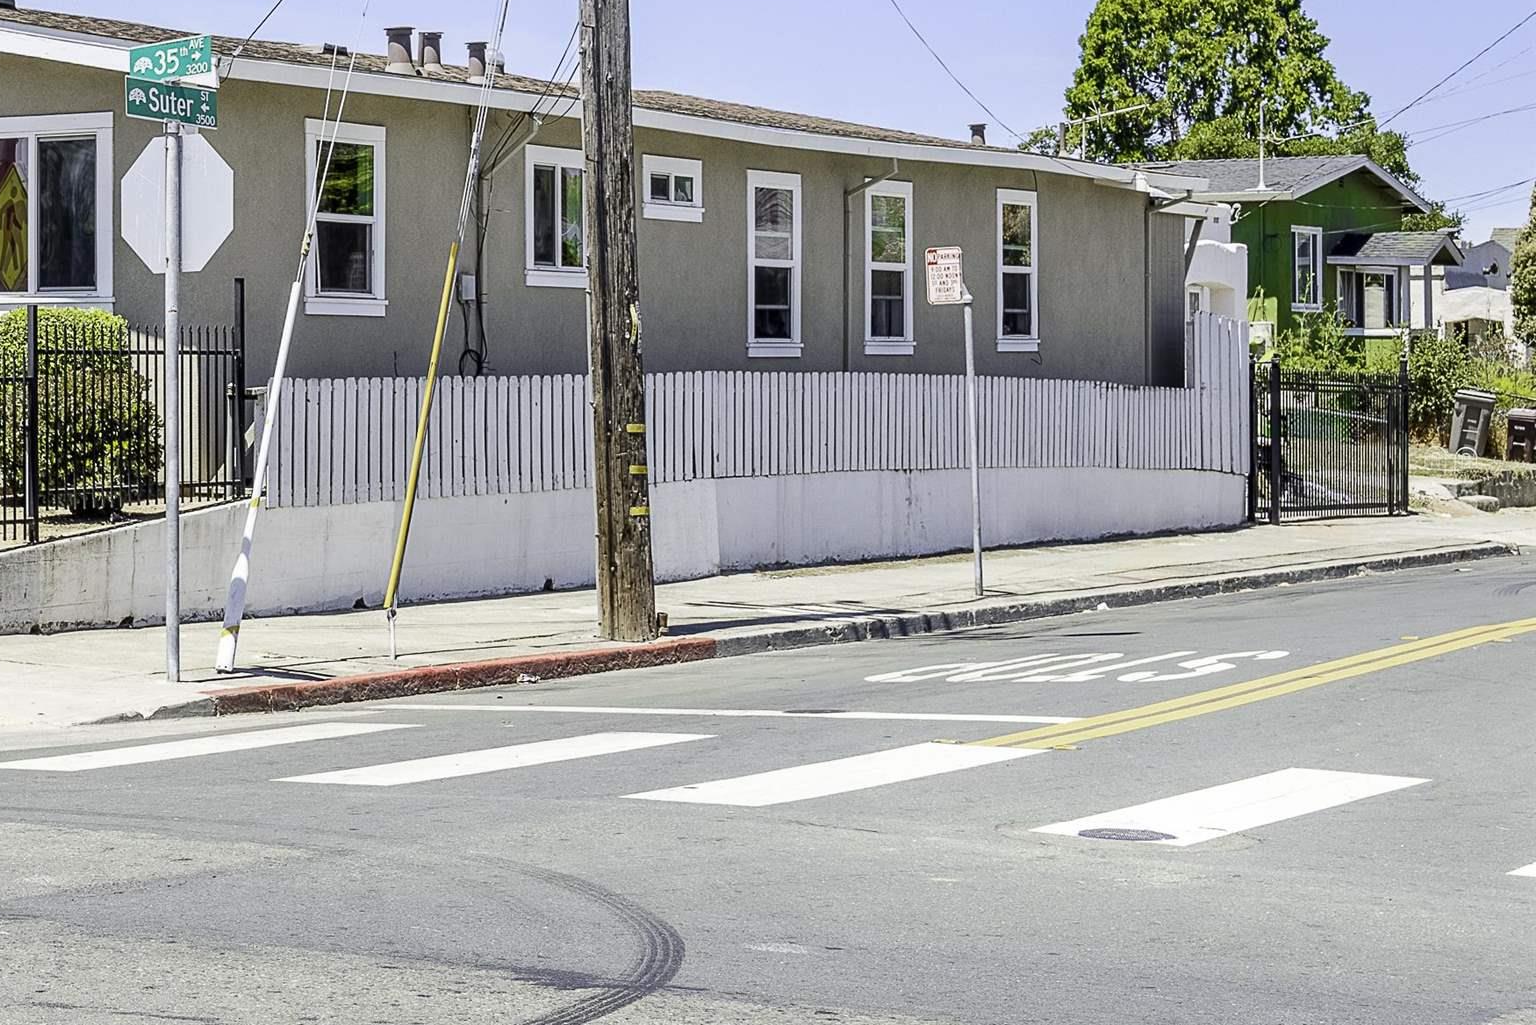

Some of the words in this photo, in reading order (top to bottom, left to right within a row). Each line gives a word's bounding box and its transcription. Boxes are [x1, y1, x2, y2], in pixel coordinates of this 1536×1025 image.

[189, 38, 204, 50] AVE
[185, 62, 208, 75] 3200
[148, 87, 194, 117] Suter
[200, 91, 210, 101] ST
[195, 114, 216, 126] 3500
